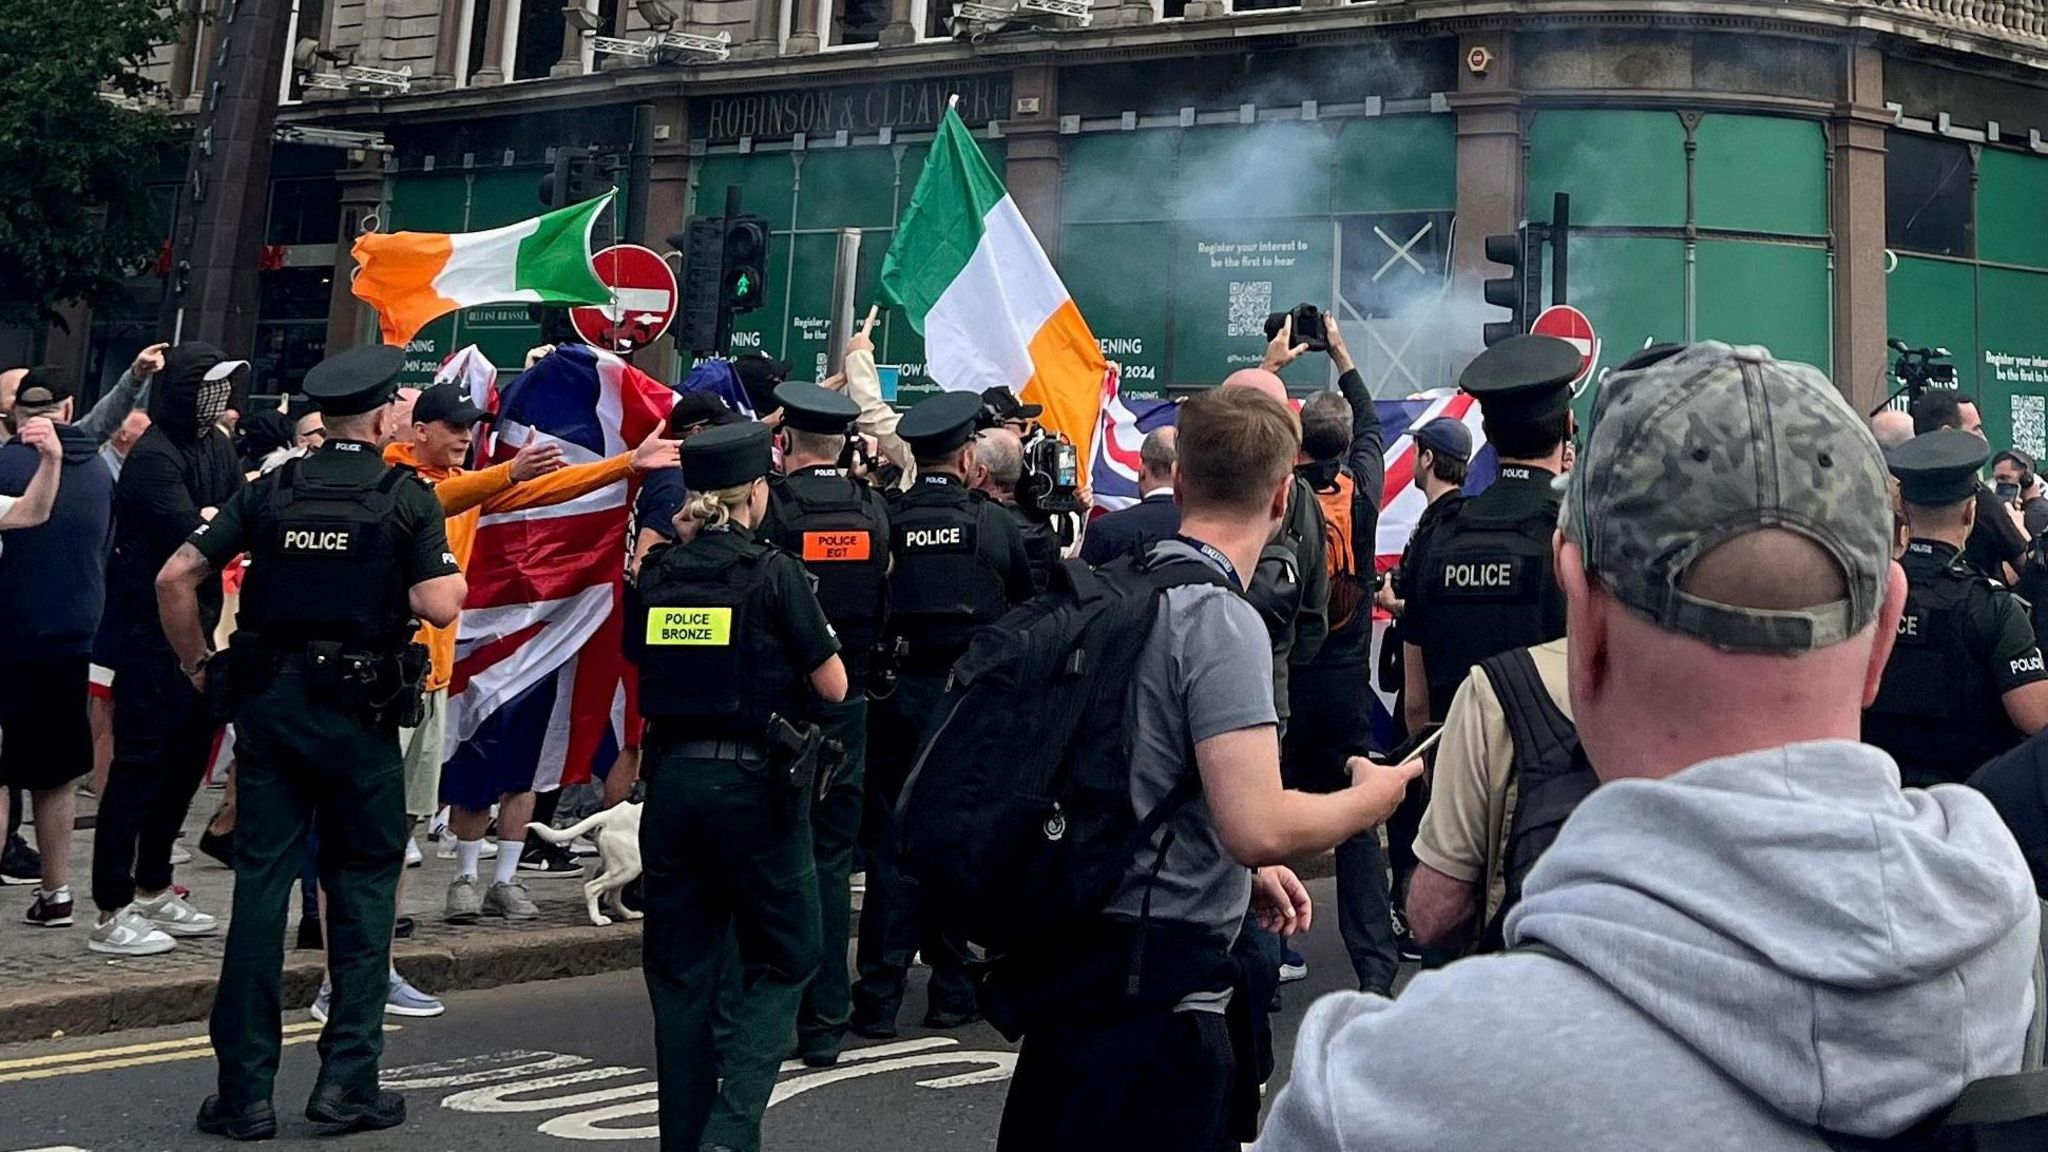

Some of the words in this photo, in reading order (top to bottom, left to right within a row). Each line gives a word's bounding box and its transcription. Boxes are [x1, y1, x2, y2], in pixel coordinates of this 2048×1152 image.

[709, 91, 833, 138] ROBINSON
[839, 96, 854, 129] &
[1198, 242, 1234, 254] Register
[1236, 244, 1257, 254] your
[1259, 240, 1295, 251] interest
[1297, 240, 1308, 250] to
[1210, 257, 1222, 267] be
[1224, 257, 1239, 267] the
[1241, 256, 1260, 267] first
[1262, 257, 1272, 266] to
[1274, 256, 1295, 266] hear
[794, 317, 823, 328] Register
[730, 331, 760, 347] NING
[803, 330, 813, 339] be
[814, 330, 827, 339] the
[1986, 350, 2014, 366] Register
[2015, 356, 2031, 368] your
[1125, 365, 1155, 380] 2024
[1996, 367, 2006, 381] be
[2007, 367, 2019, 381] the
[2020, 367, 2034, 382] first
[2035, 370, 2042, 382] to
[925, 477, 947, 485] POLICE
[1503, 469, 1530, 479] POLICE
[284, 531, 348, 550] POLICE
[818, 536, 856, 546] POLICE
[907, 528, 960, 547] POLICE
[1445, 564, 1511, 587] POLICE
[665, 613, 710, 625] POLICE
[662, 628, 712, 640] BRONZE
